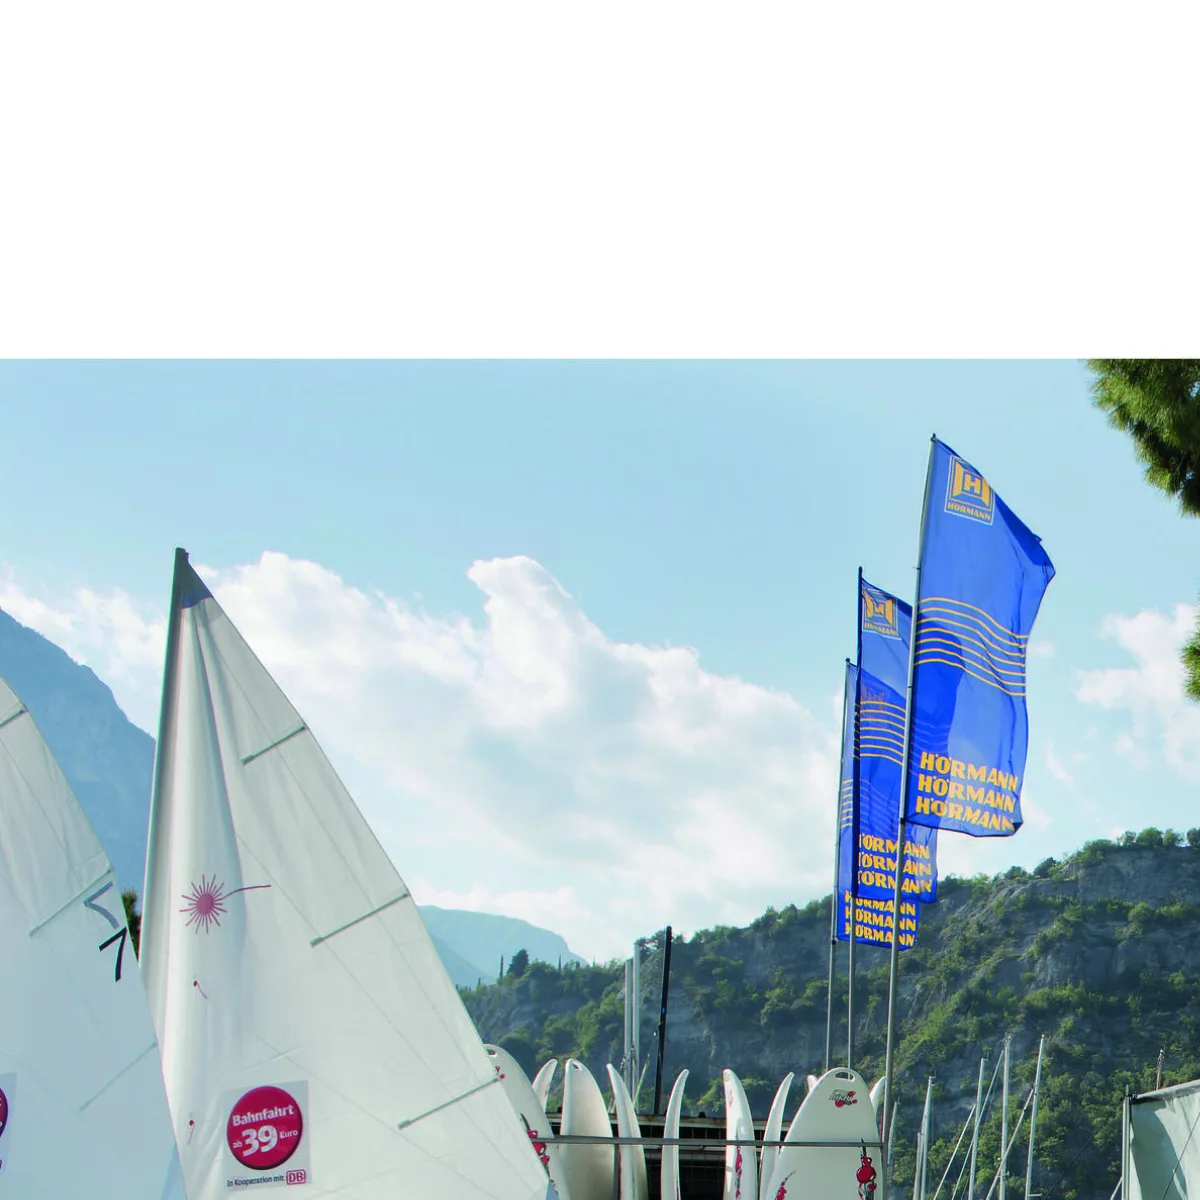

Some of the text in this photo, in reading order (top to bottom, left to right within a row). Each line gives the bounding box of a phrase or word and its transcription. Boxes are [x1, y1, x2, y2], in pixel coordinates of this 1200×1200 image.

[920, 751, 1018, 792] HÖRMANN
[918, 773, 1016, 814] HÖRMANN
[915, 796, 1015, 831] HÖRMANN
[859, 833, 930, 859] ÖRMANN
[858, 851, 932, 877] ÖRMANN
[232, 1104, 294, 1127] Bahnfahrt
[232, 1124, 299, 1157] ab 39 Euro
[234, 1175, 273, 1187] Kooperation
[287, 1171, 305, 1184] DB
